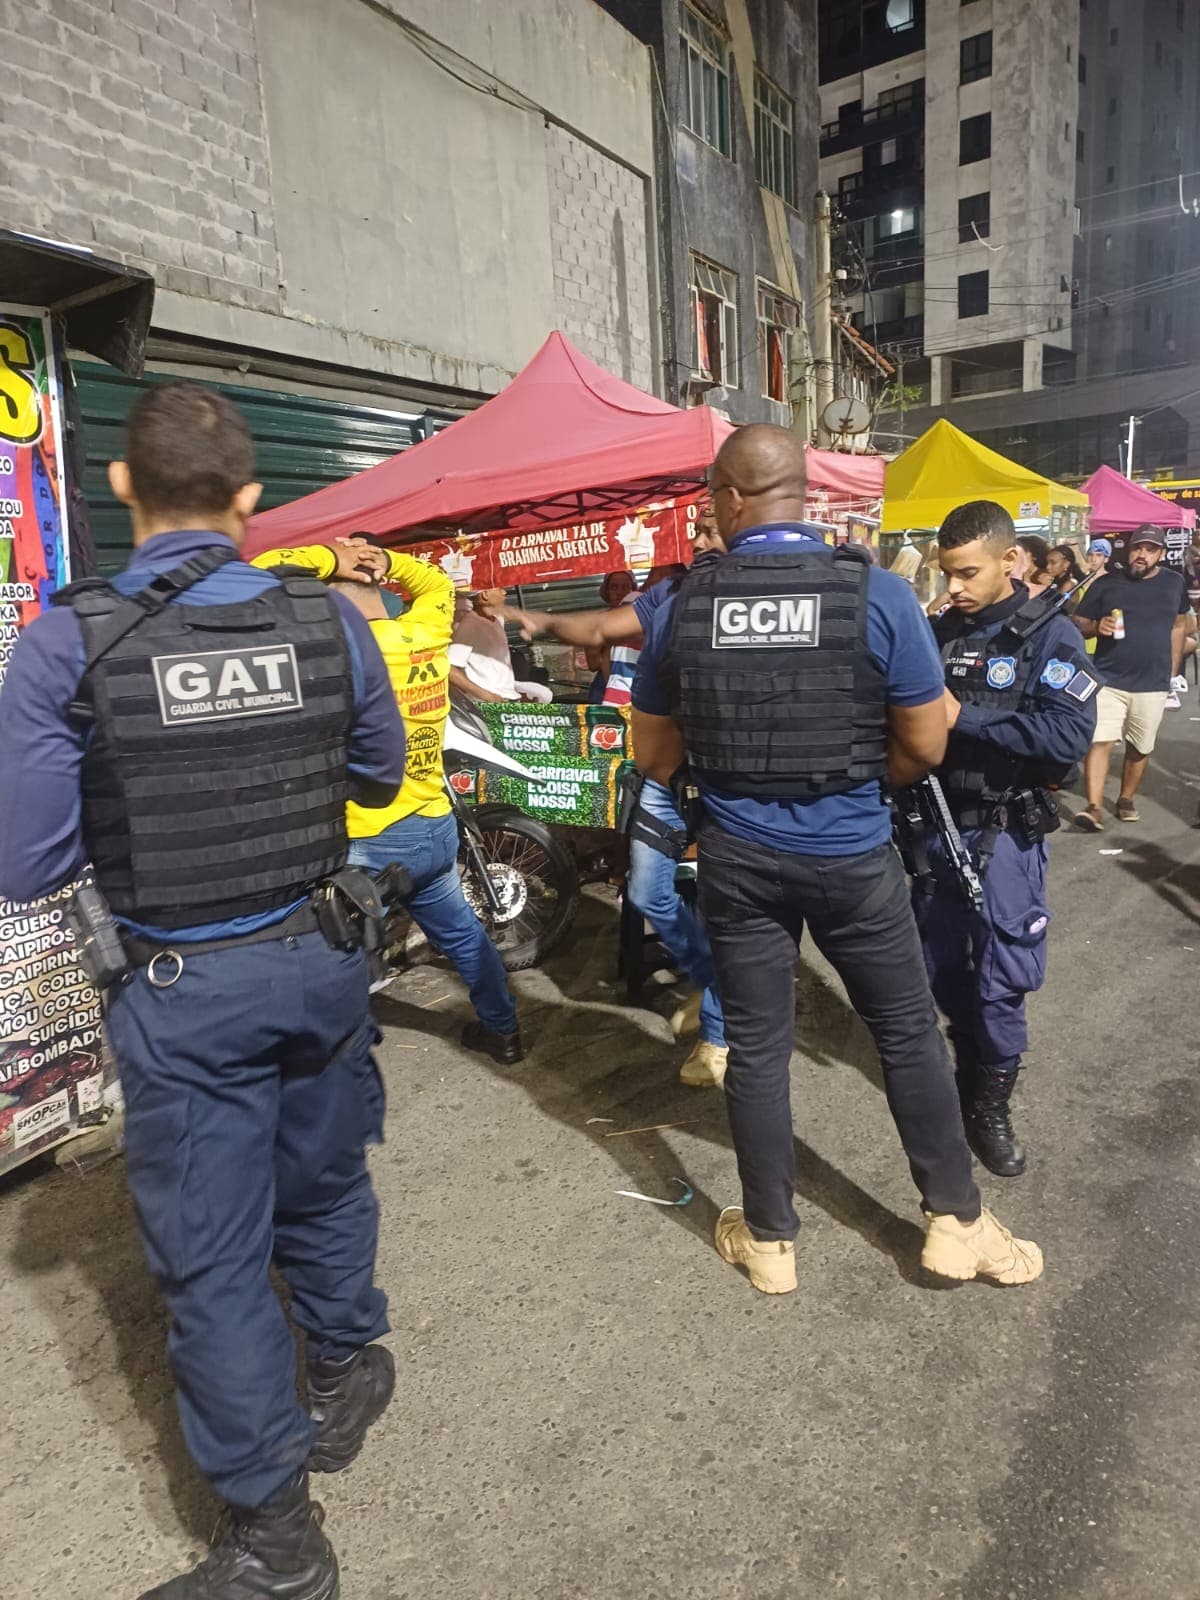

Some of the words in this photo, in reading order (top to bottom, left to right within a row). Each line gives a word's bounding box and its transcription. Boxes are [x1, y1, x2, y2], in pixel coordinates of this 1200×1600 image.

[501, 538, 511, 551] O
[512, 528, 570, 549] CARNAVAL
[590, 521, 608, 537] DE
[498, 544, 555, 568] BRAHMAS
[556, 536, 610, 560] ABERTAS
[0, 585, 33, 598] ABOR
[719, 599, 815, 634] GCM
[164, 653, 290, 701] GAT
[170, 701, 214, 716] GUARDA
[215, 698, 243, 711] CIVIL
[243, 691, 296, 708] MUNICIPAL
[502, 738, 551, 753] NOSSA
[513, 725, 555, 740] COISA
[528, 794, 577, 810] NOSSA
[0, 928, 76, 966] AIPIROS
[0, 949, 83, 989] CAIPIRIN
